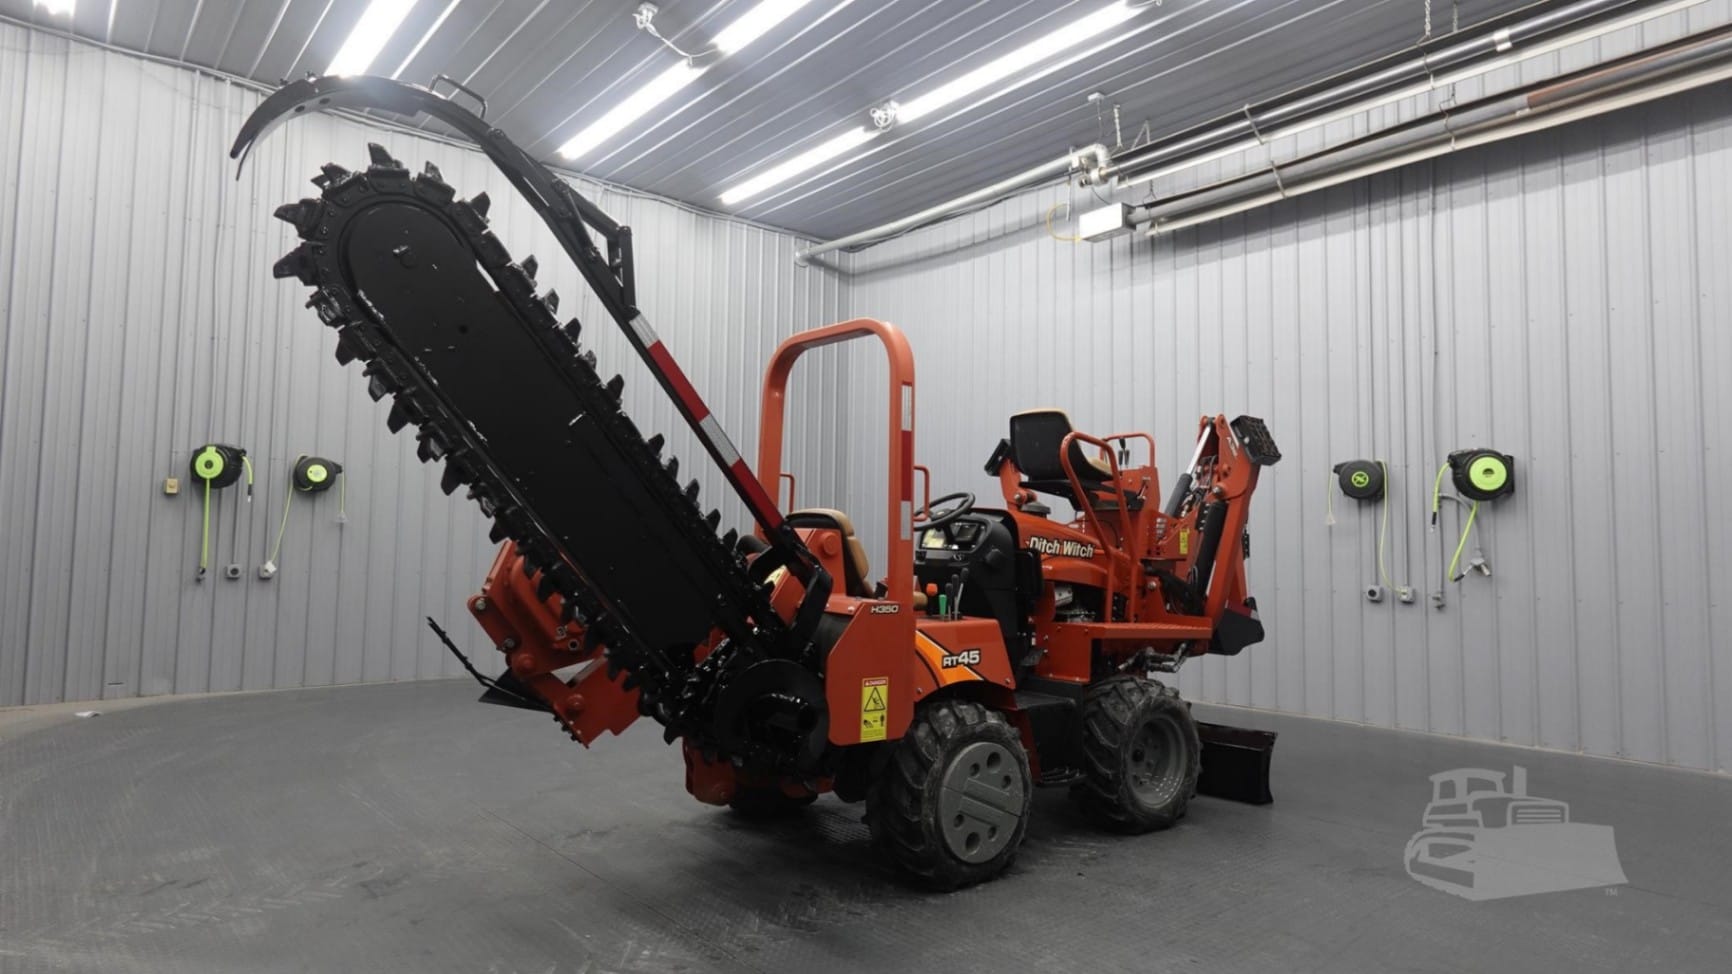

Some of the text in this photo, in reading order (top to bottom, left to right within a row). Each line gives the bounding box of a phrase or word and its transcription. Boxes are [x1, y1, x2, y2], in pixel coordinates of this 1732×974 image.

[1030, 537, 1094, 558] Ditch Witch
[871, 605, 899, 614] H350
[943, 650, 980, 667] RT45
